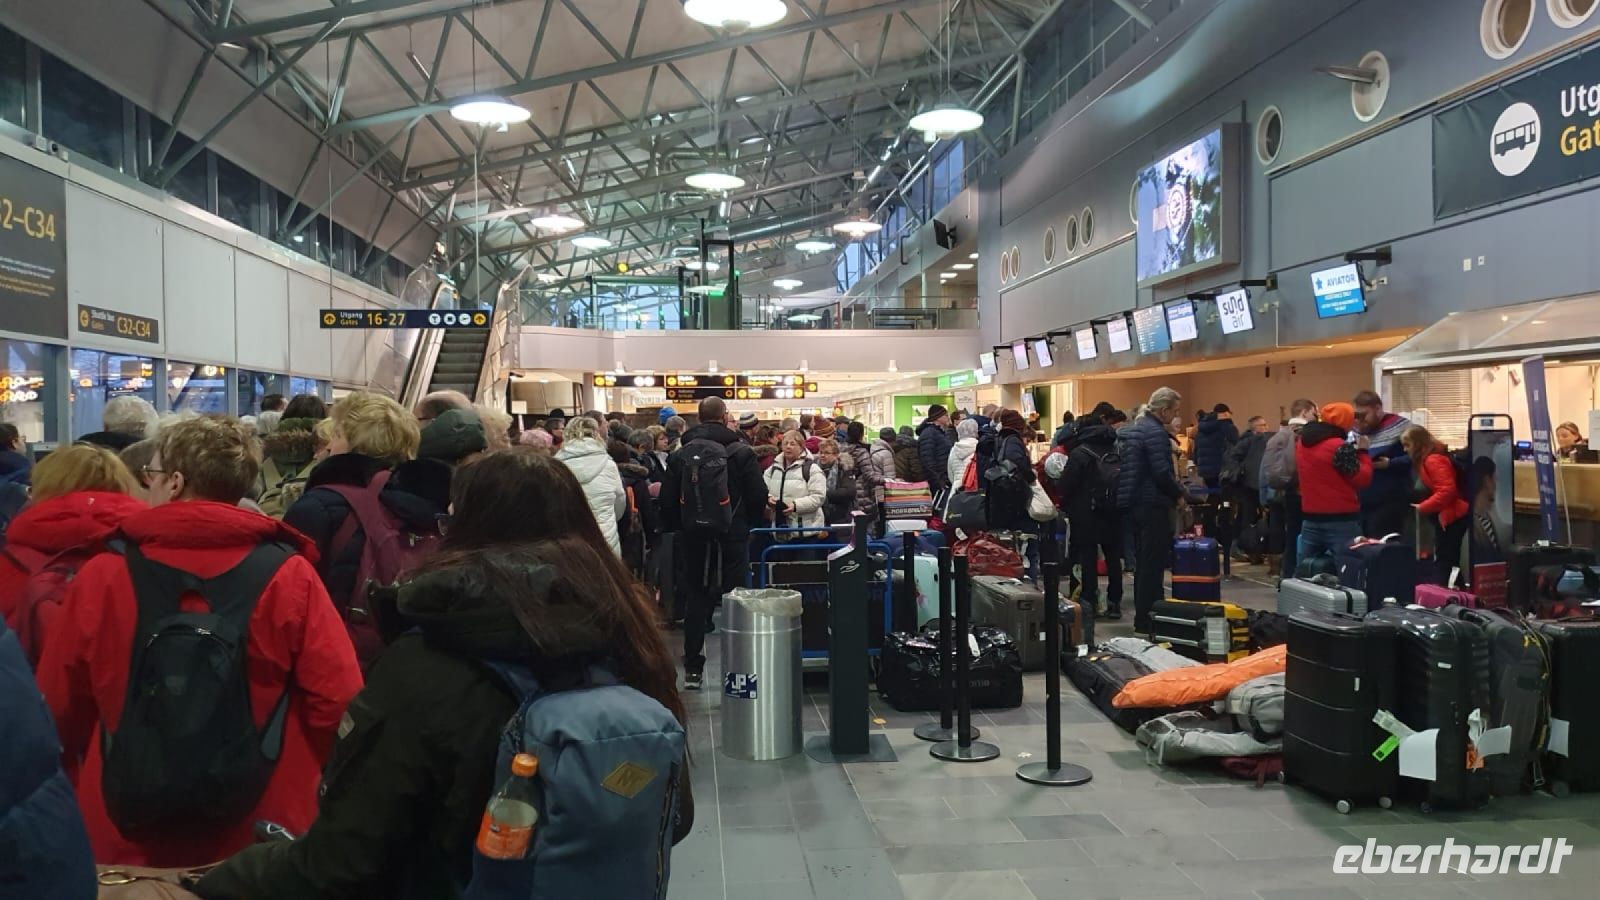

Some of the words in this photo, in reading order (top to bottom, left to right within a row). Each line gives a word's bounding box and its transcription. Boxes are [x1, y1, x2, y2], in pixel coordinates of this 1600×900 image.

[1327, 273, 1356, 287] AVIATOR
[117, 316, 151, 338] C32-C34
[367, 312, 406, 327] 16-27
[1231, 314, 1244, 329] air
